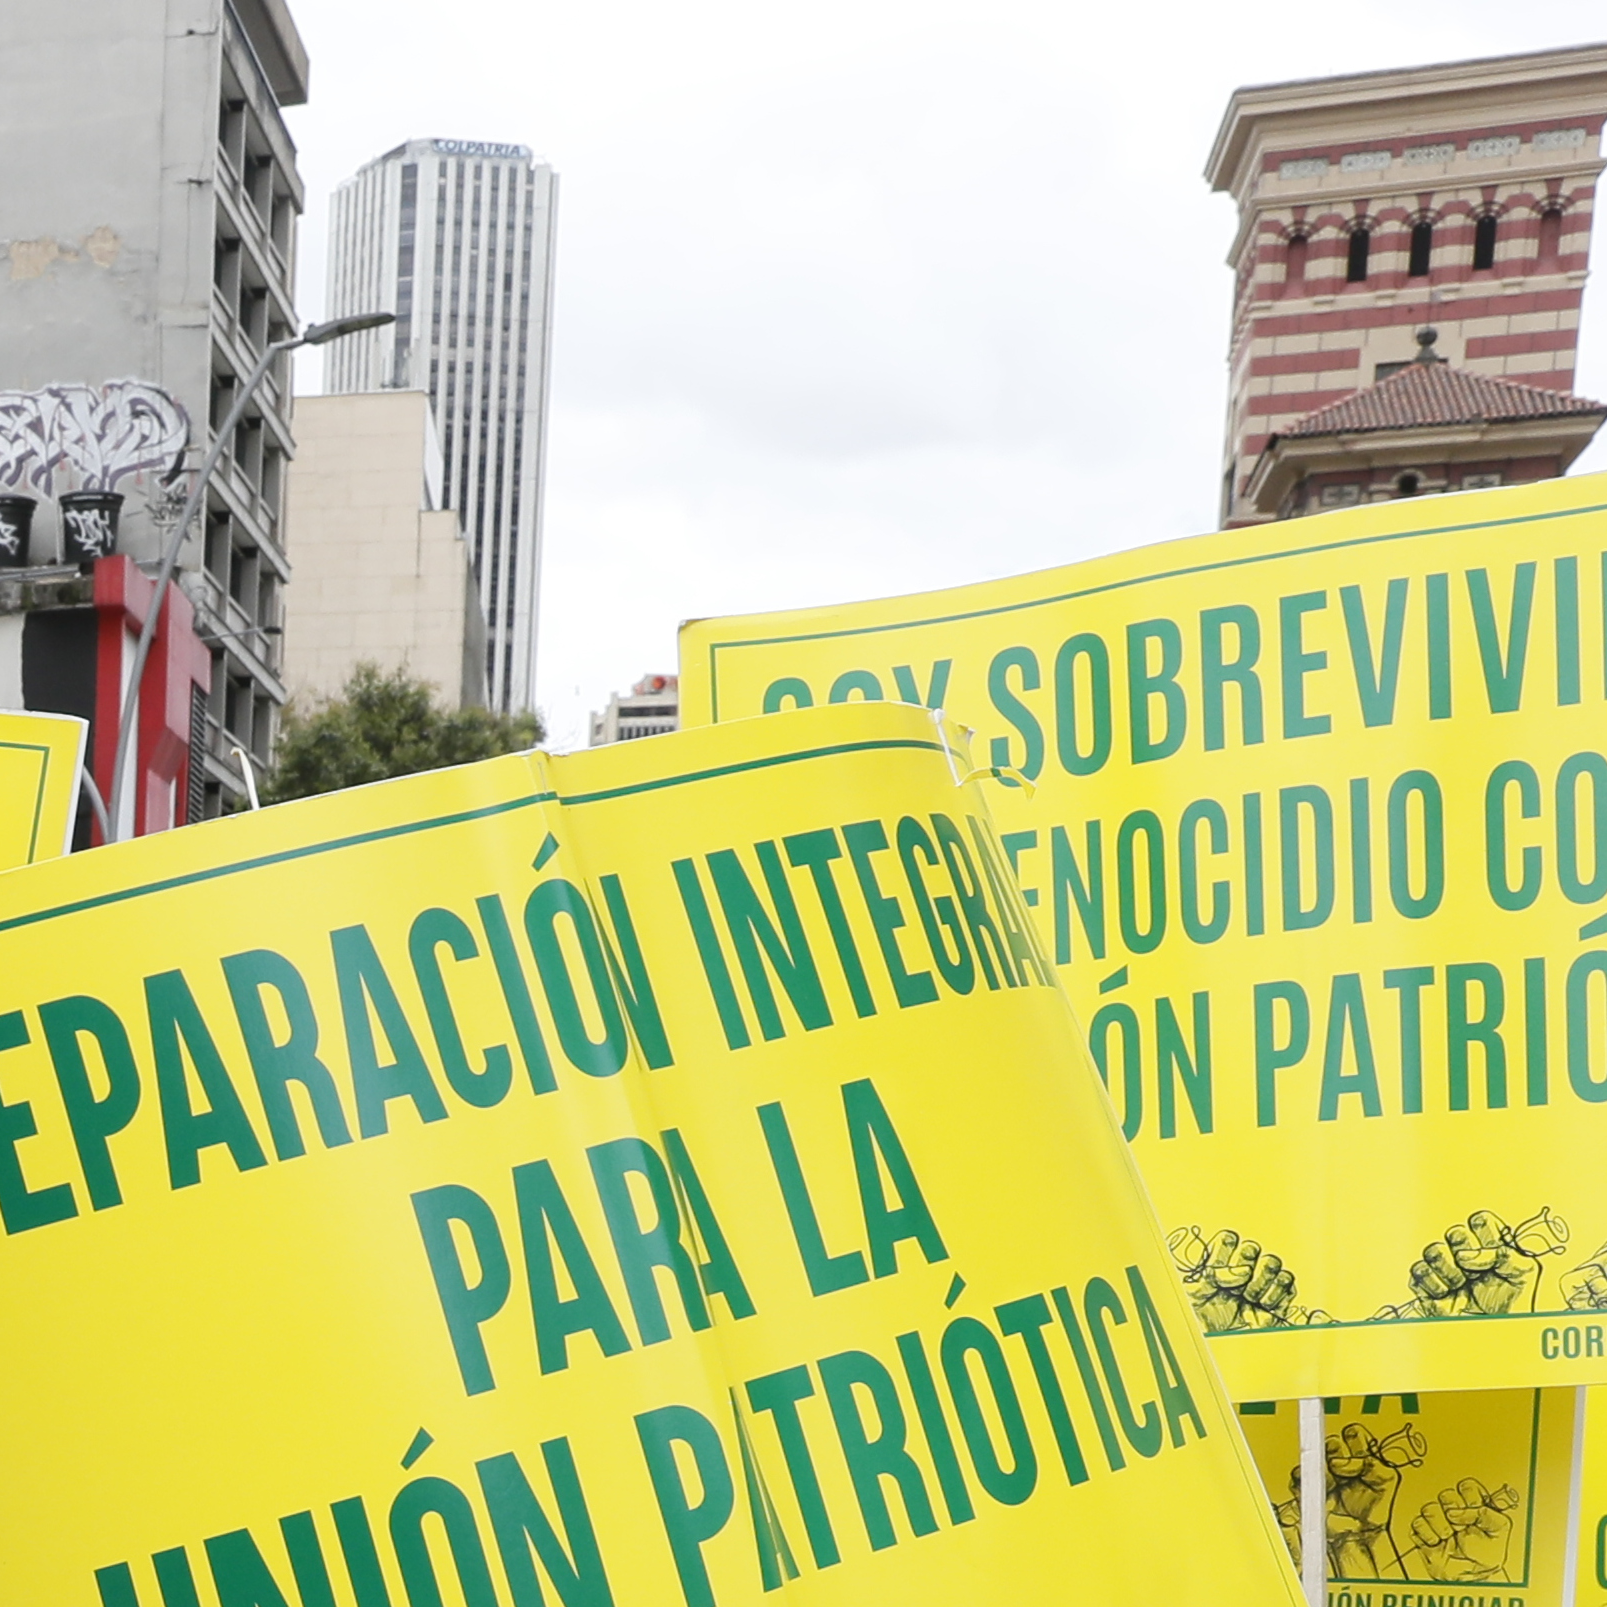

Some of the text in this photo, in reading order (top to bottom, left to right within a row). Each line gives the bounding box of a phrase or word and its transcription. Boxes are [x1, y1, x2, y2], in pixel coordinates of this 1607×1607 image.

[987, 551, 1607, 788] SOBREVIVI
[414, 1077, 949, 1397] PARA LA
